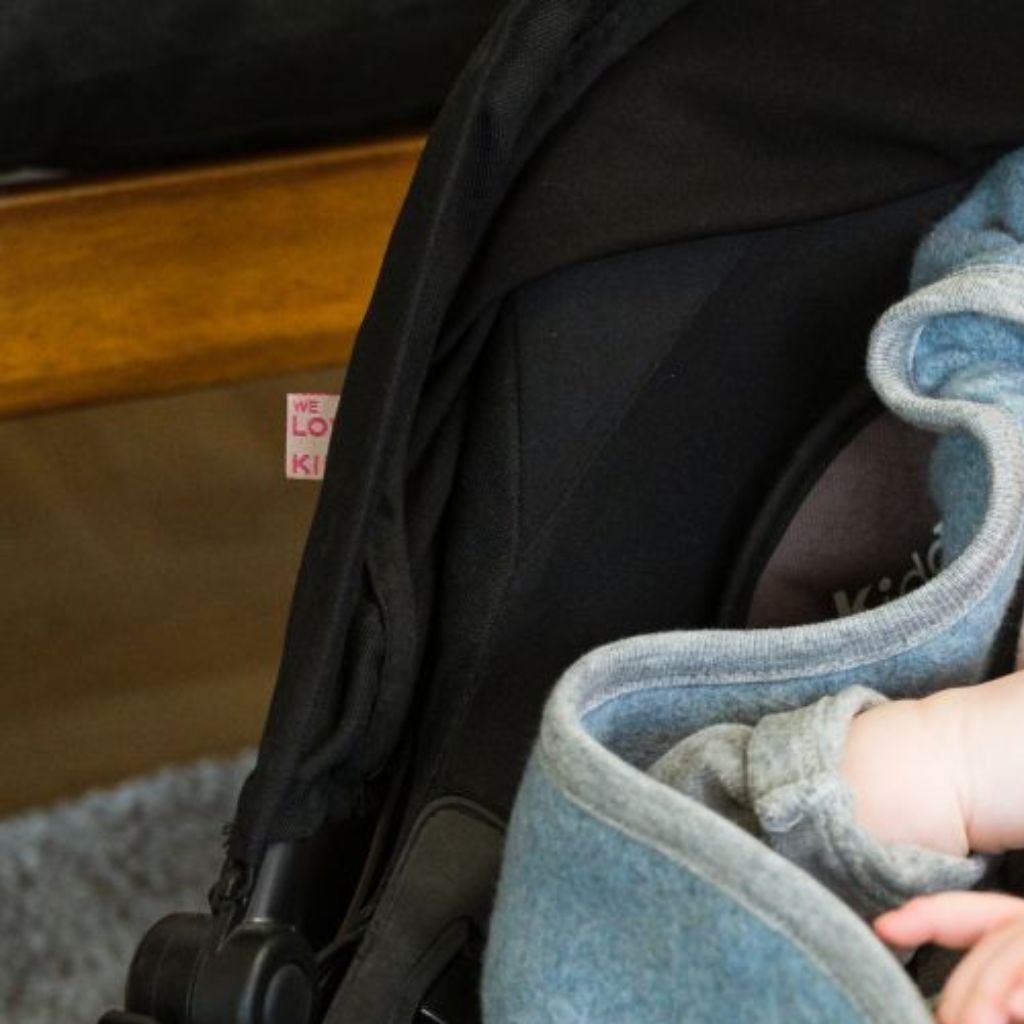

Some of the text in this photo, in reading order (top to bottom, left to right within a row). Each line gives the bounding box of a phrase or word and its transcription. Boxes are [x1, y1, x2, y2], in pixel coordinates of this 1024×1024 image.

[294, 401, 319, 413] WE
[292, 416, 335, 437] LO
[292, 454, 322, 475] KI
